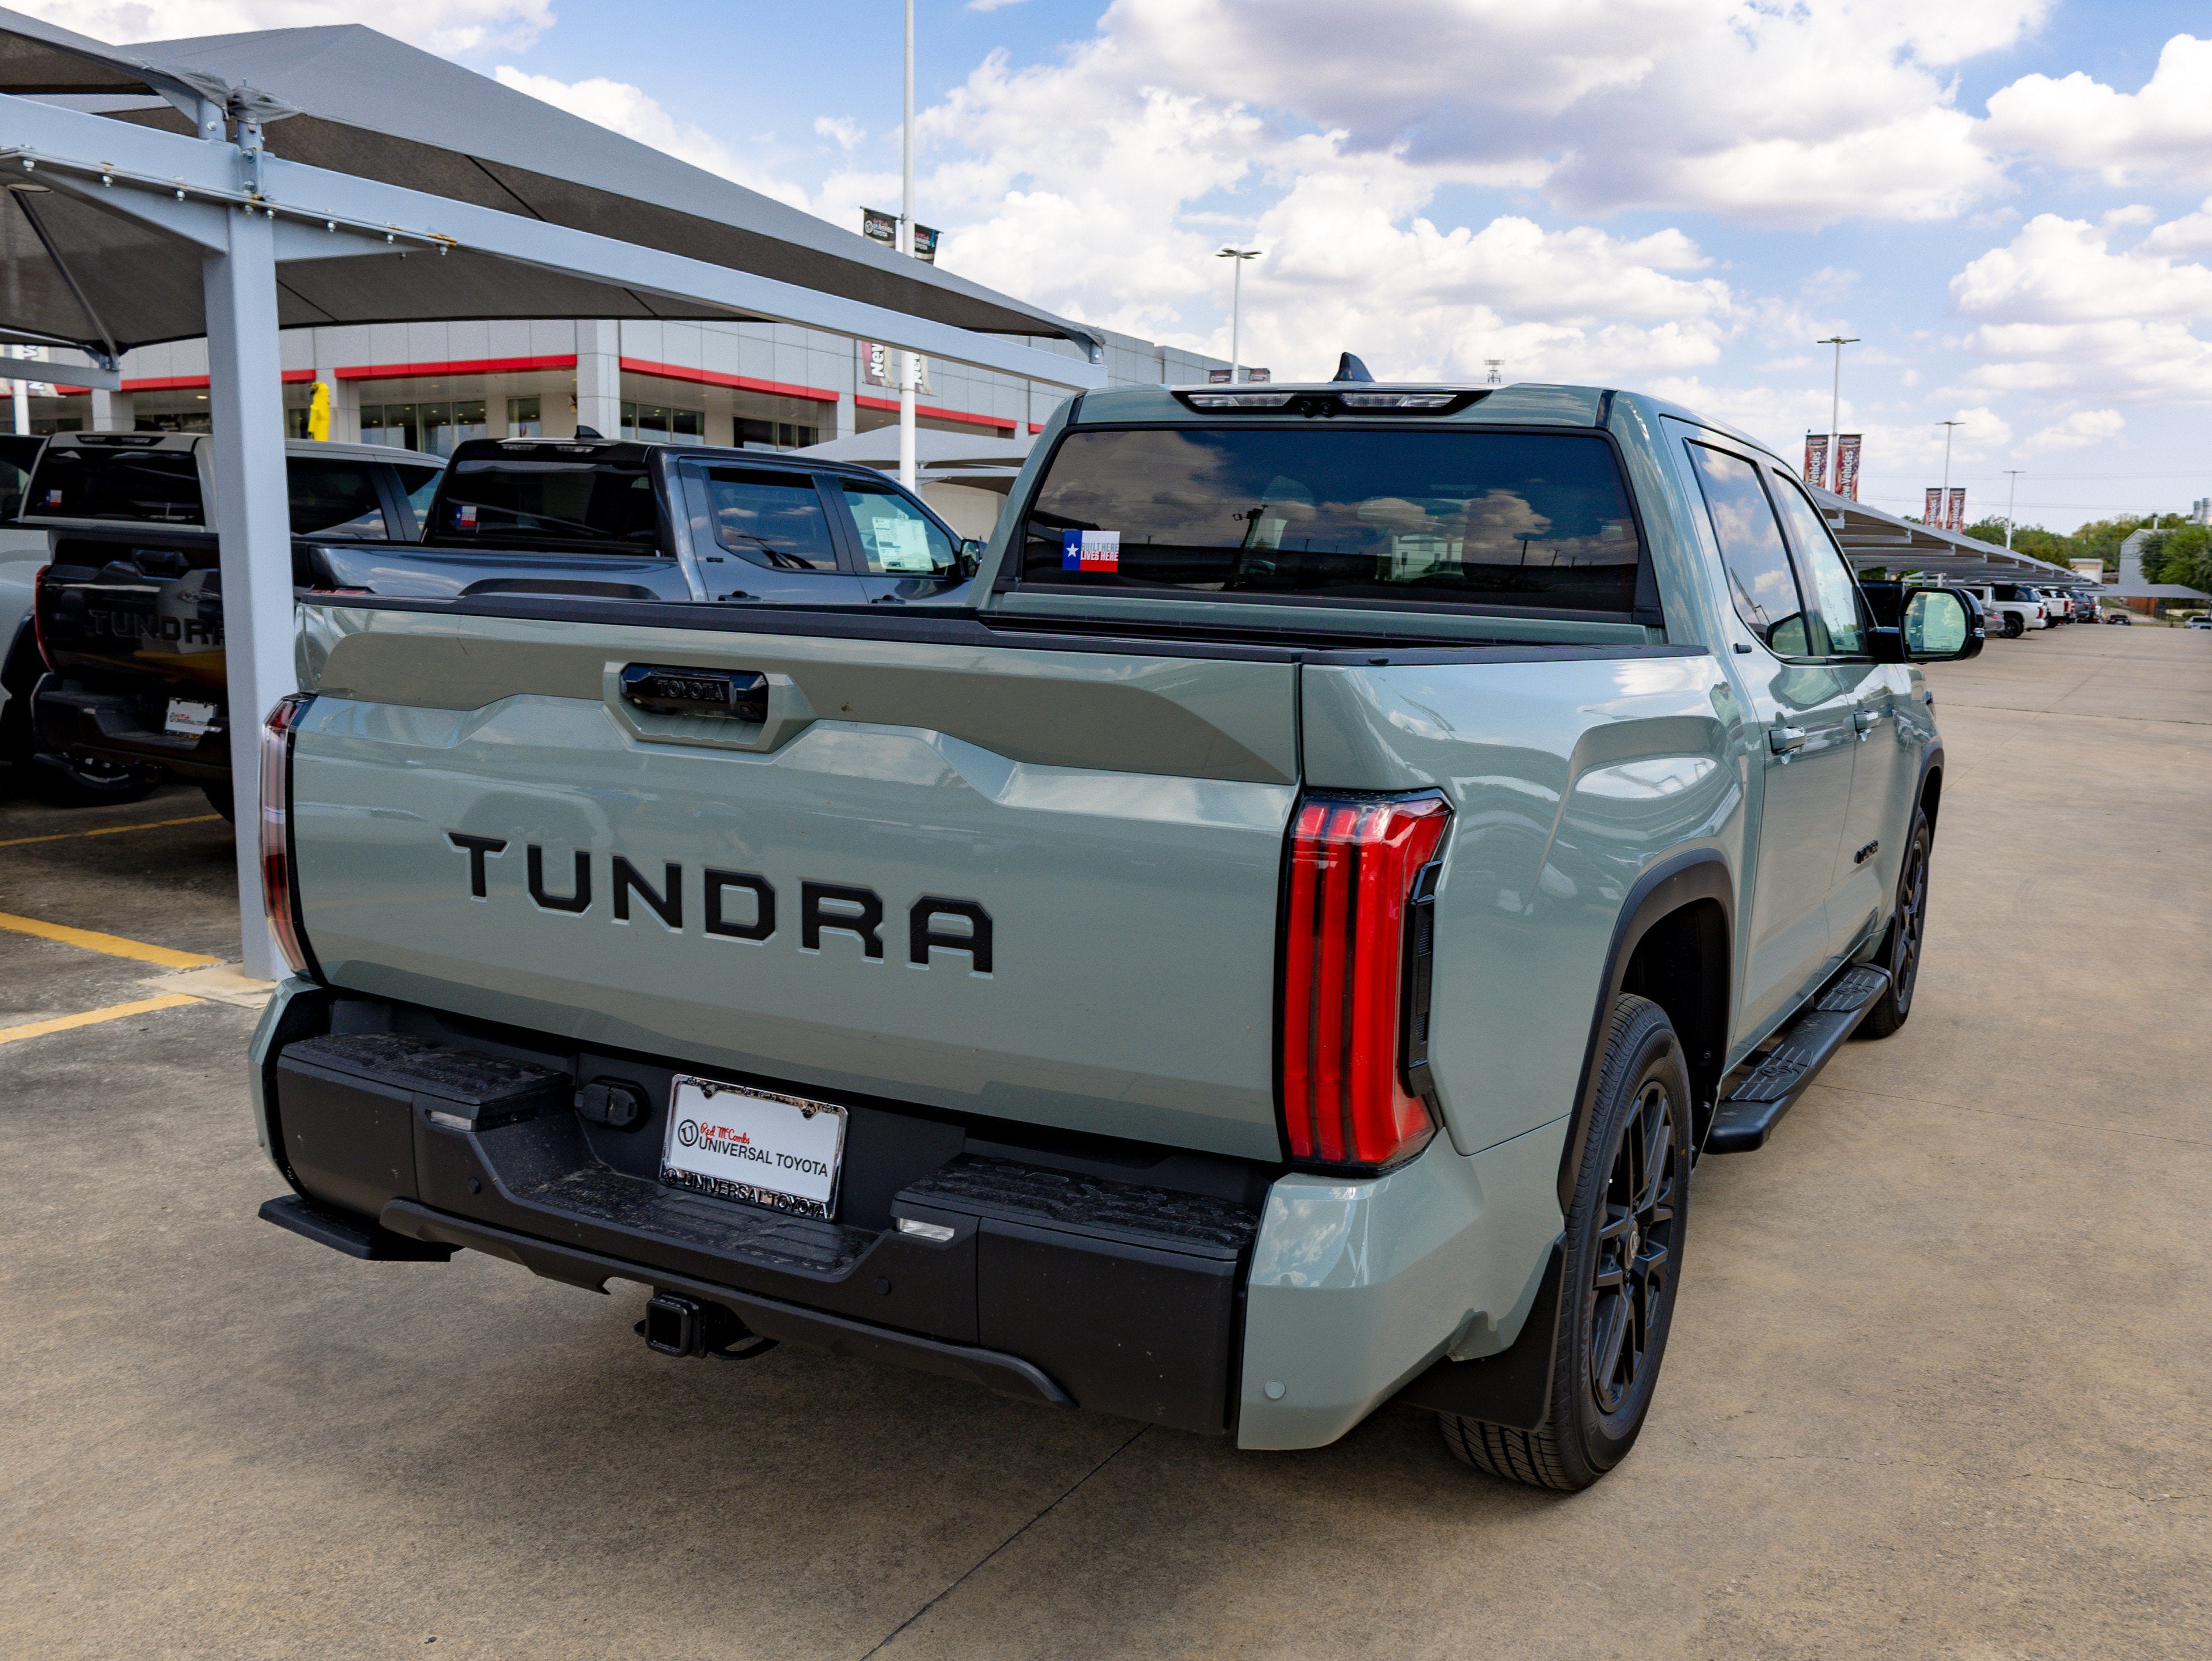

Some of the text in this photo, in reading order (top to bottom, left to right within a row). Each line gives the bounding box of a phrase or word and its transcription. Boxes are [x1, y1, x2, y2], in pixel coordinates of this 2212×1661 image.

[1080, 551, 1119, 561] LIVES HERE
[1081, 543, 1119, 552] BUILT HERE
[657, 679, 724, 701] TOYOTA
[444, 831, 994, 976] TUNDRA
[700, 1122, 750, 1145] Red McCombs
[699, 1136, 773, 1165] UNIVERSAL
[776, 1153, 828, 1177] TOYOTA
[684, 1171, 828, 1220] UNIVERSAL TOYOTA
